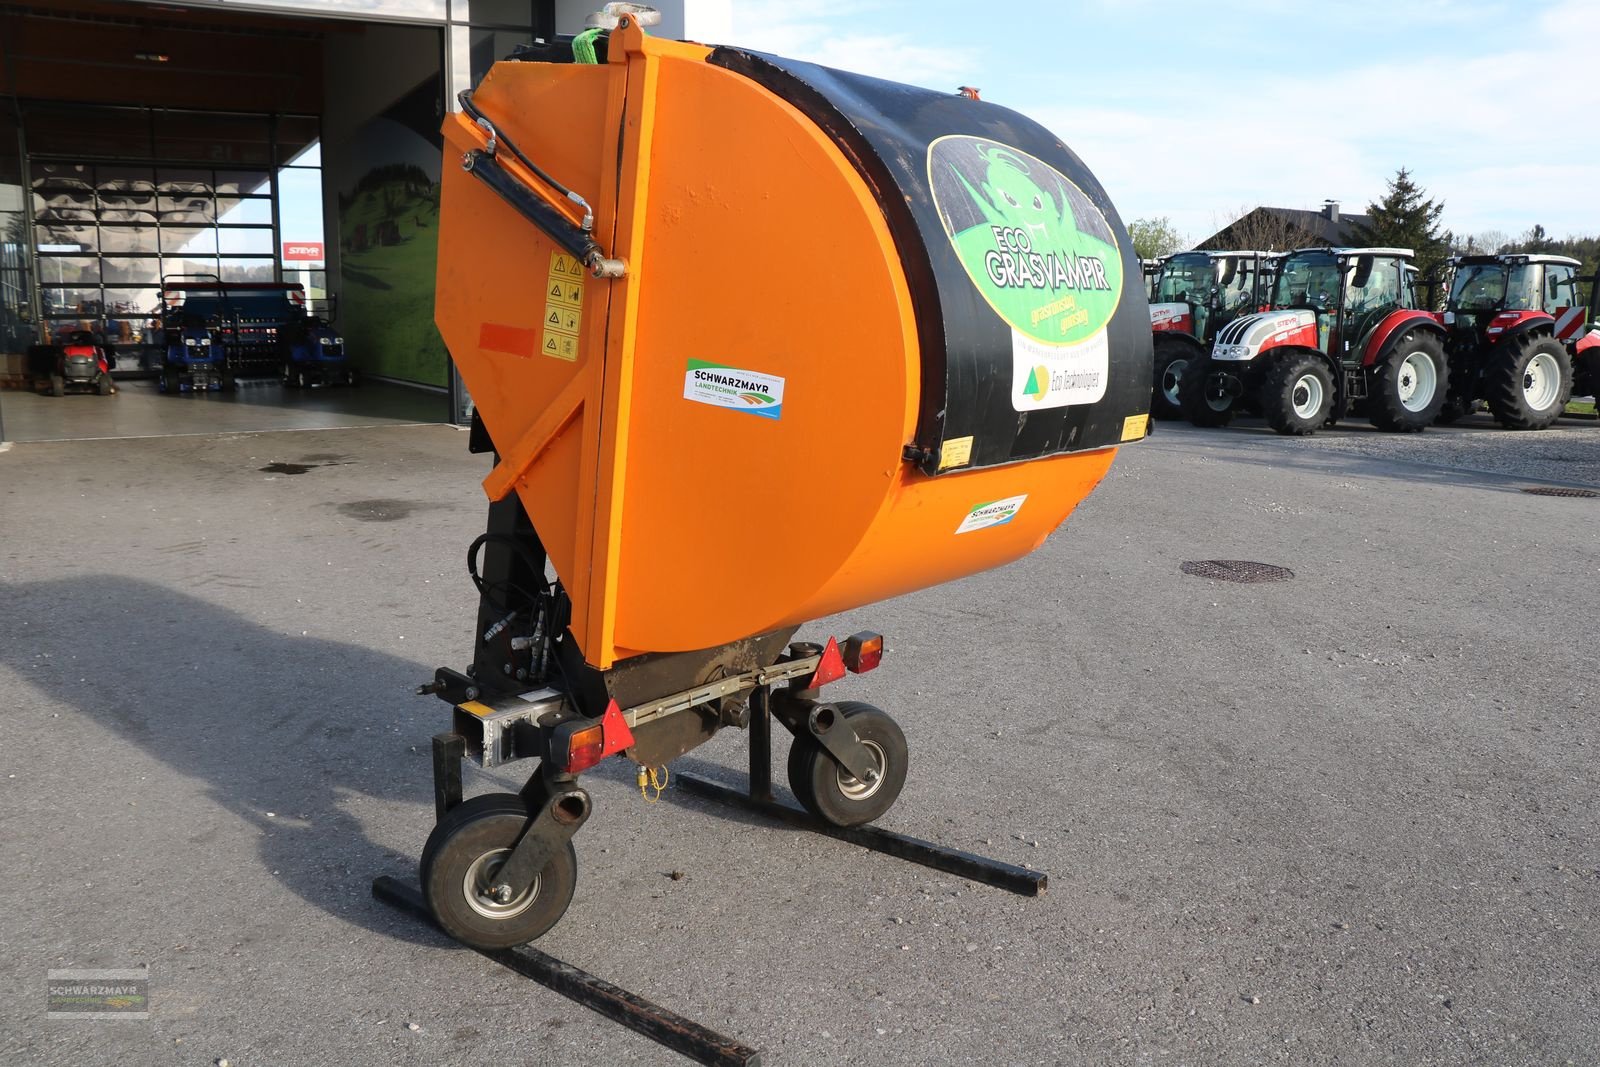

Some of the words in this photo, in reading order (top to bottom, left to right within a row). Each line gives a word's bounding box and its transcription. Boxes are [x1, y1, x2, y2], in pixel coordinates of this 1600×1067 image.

[991, 226, 1031, 253] ECO
[288, 247, 319, 255] STEYR
[985, 249, 1112, 294] GRASVAMPIR
[1277, 317, 1297, 327] STEYR
[695, 370, 769, 394] SCHWARZMAYR
[695, 381, 738, 396] LANDTECHNIK
[1051, 370, 1063, 391] Eco
[972, 504, 1016, 518] SCHWARZMAYR
